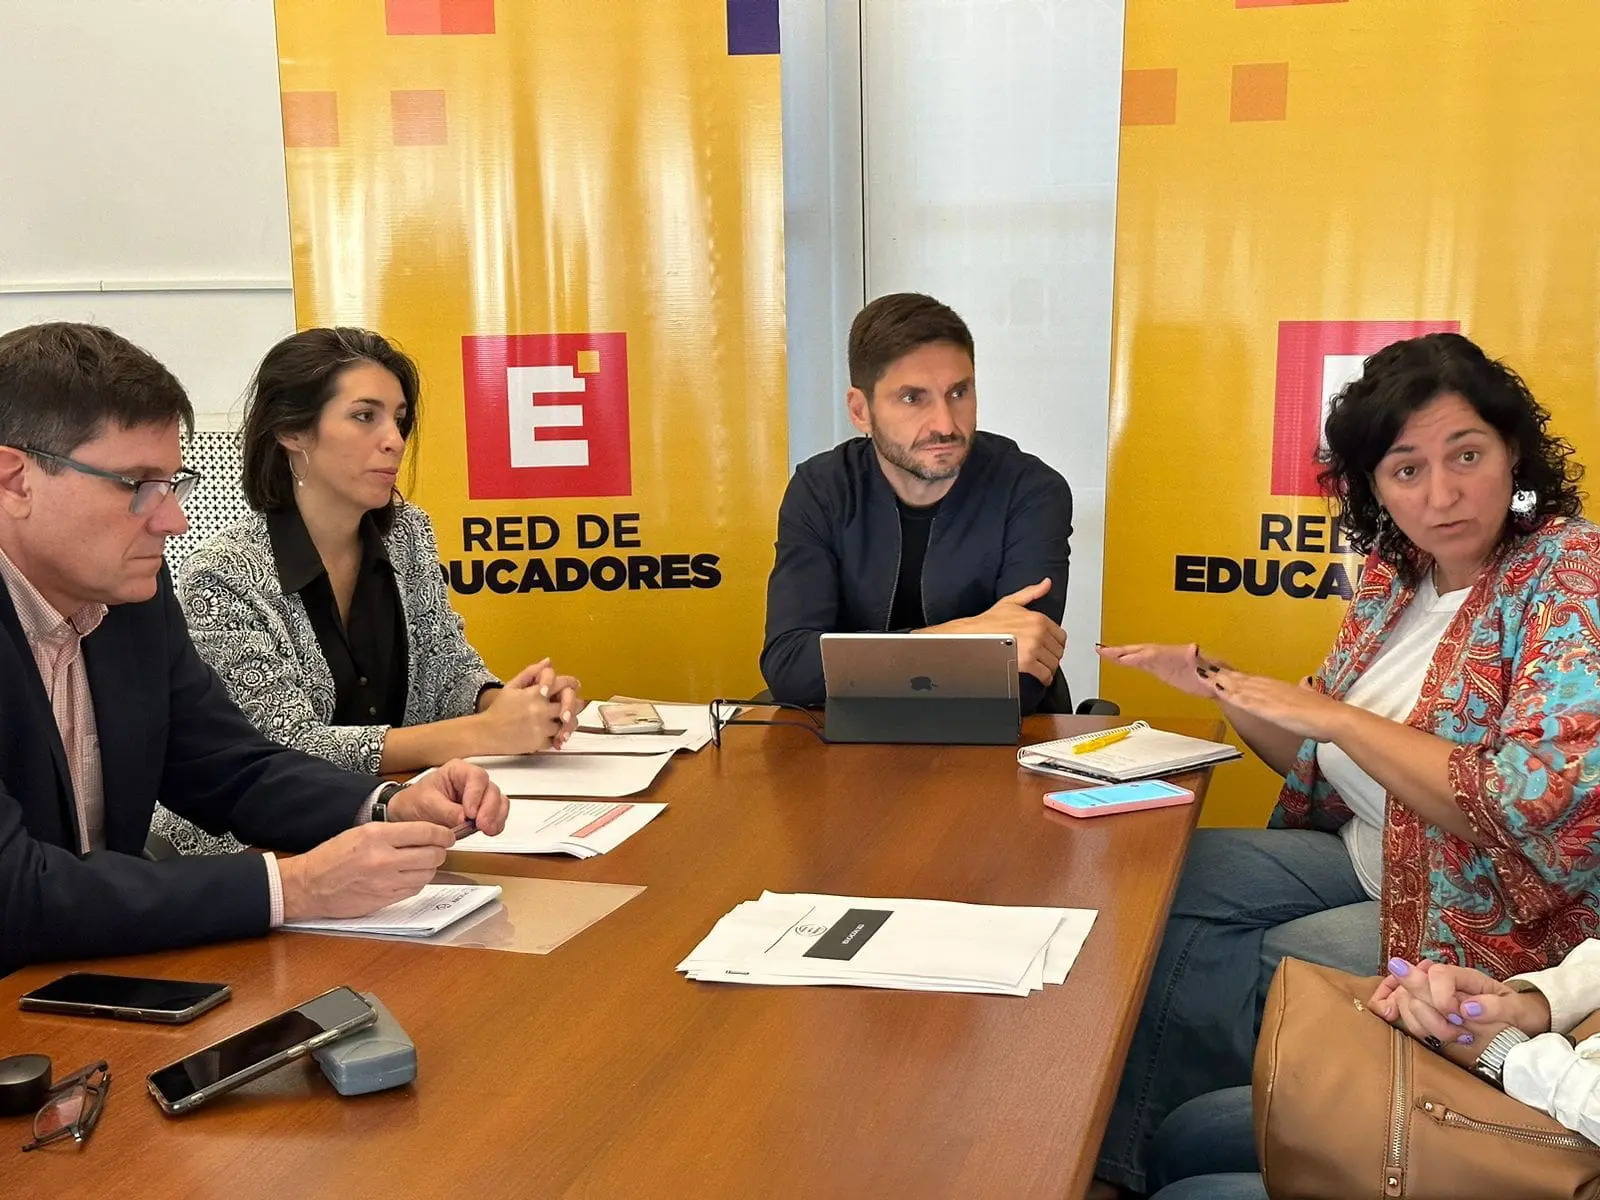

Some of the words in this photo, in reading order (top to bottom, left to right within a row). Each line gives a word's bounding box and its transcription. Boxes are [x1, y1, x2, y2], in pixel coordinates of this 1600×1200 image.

[462, 514, 560, 552] RED
[577, 513, 642, 550] DE
[440, 553, 722, 595] UCADORES
[1174, 555, 1364, 601] EDUCA
